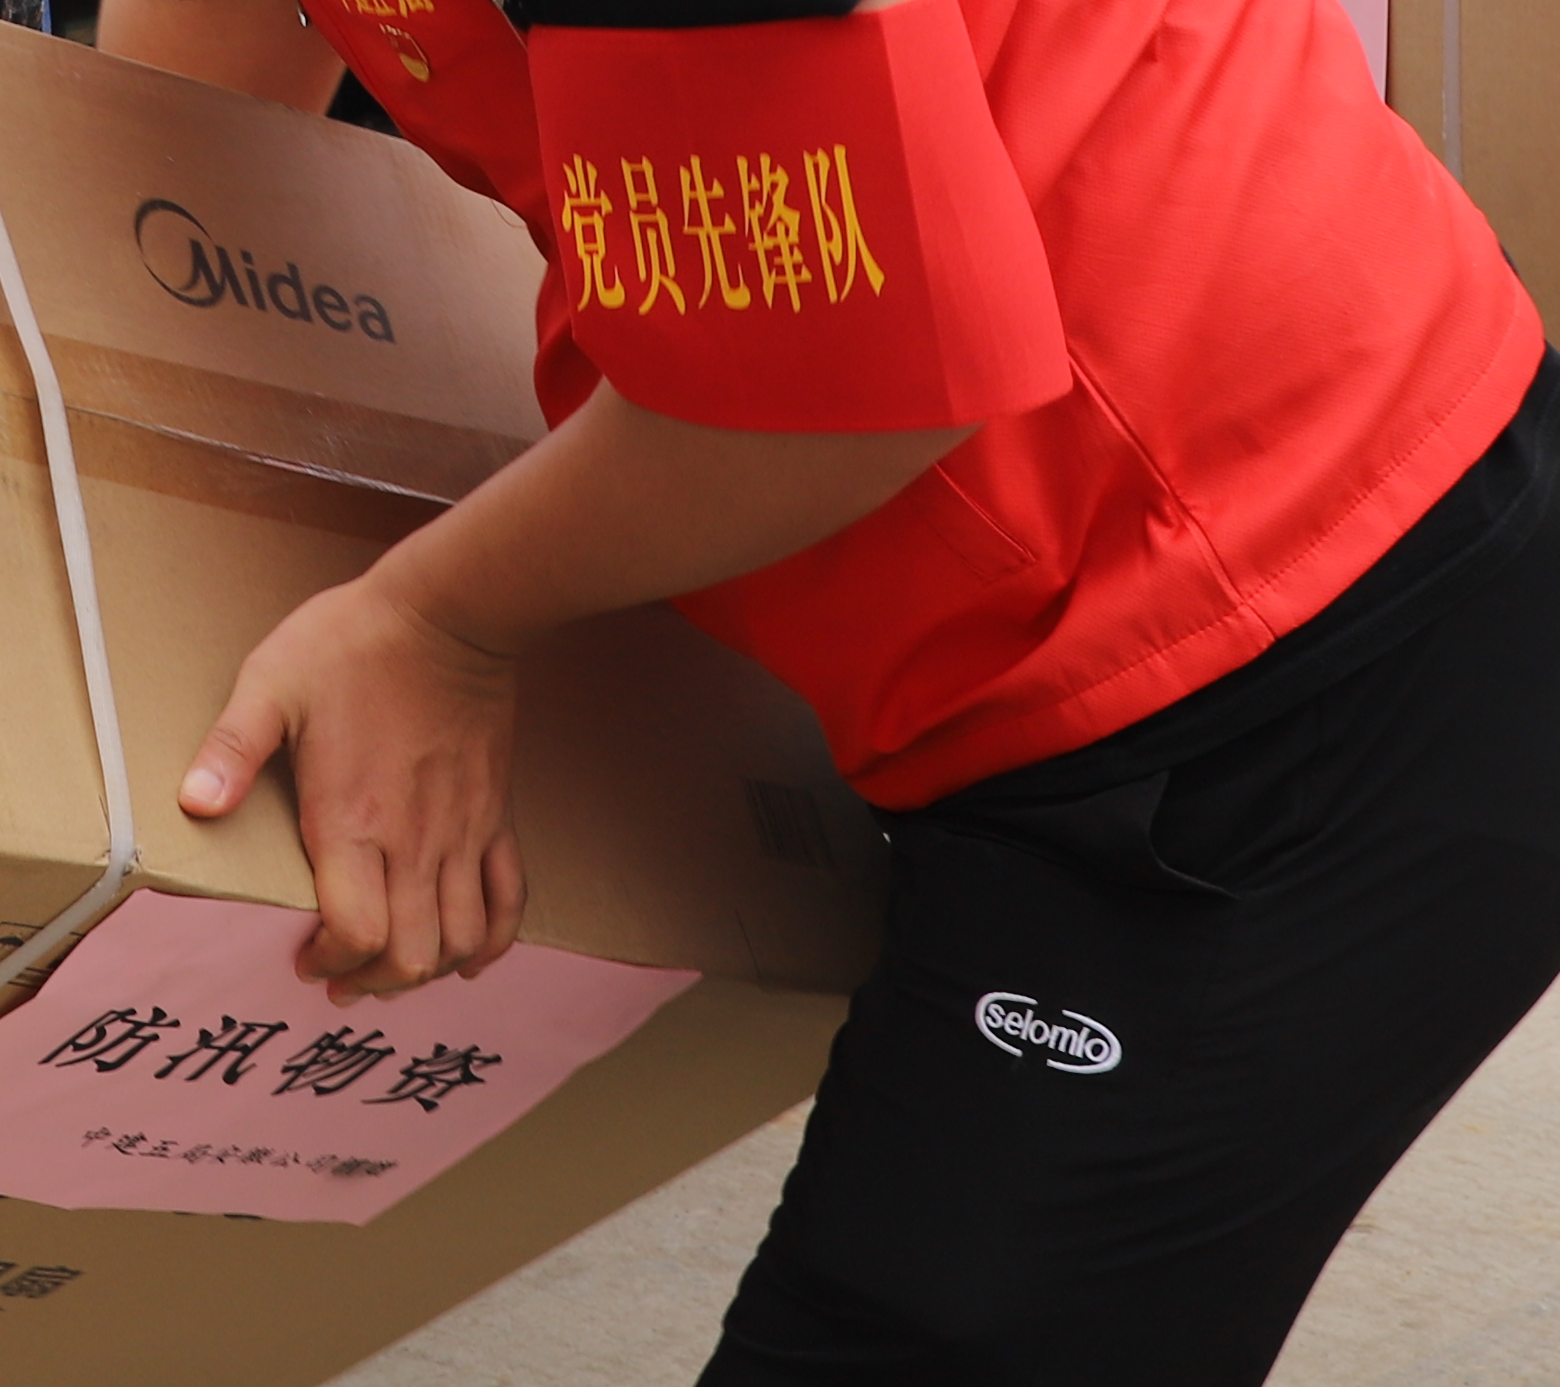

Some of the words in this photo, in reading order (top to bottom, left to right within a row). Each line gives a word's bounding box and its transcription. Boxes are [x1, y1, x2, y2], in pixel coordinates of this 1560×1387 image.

[148, 215, 396, 344] Midea
[561, 143, 885, 316] 党员先锋队
[37, 1005, 503, 1113] 防汛物资
